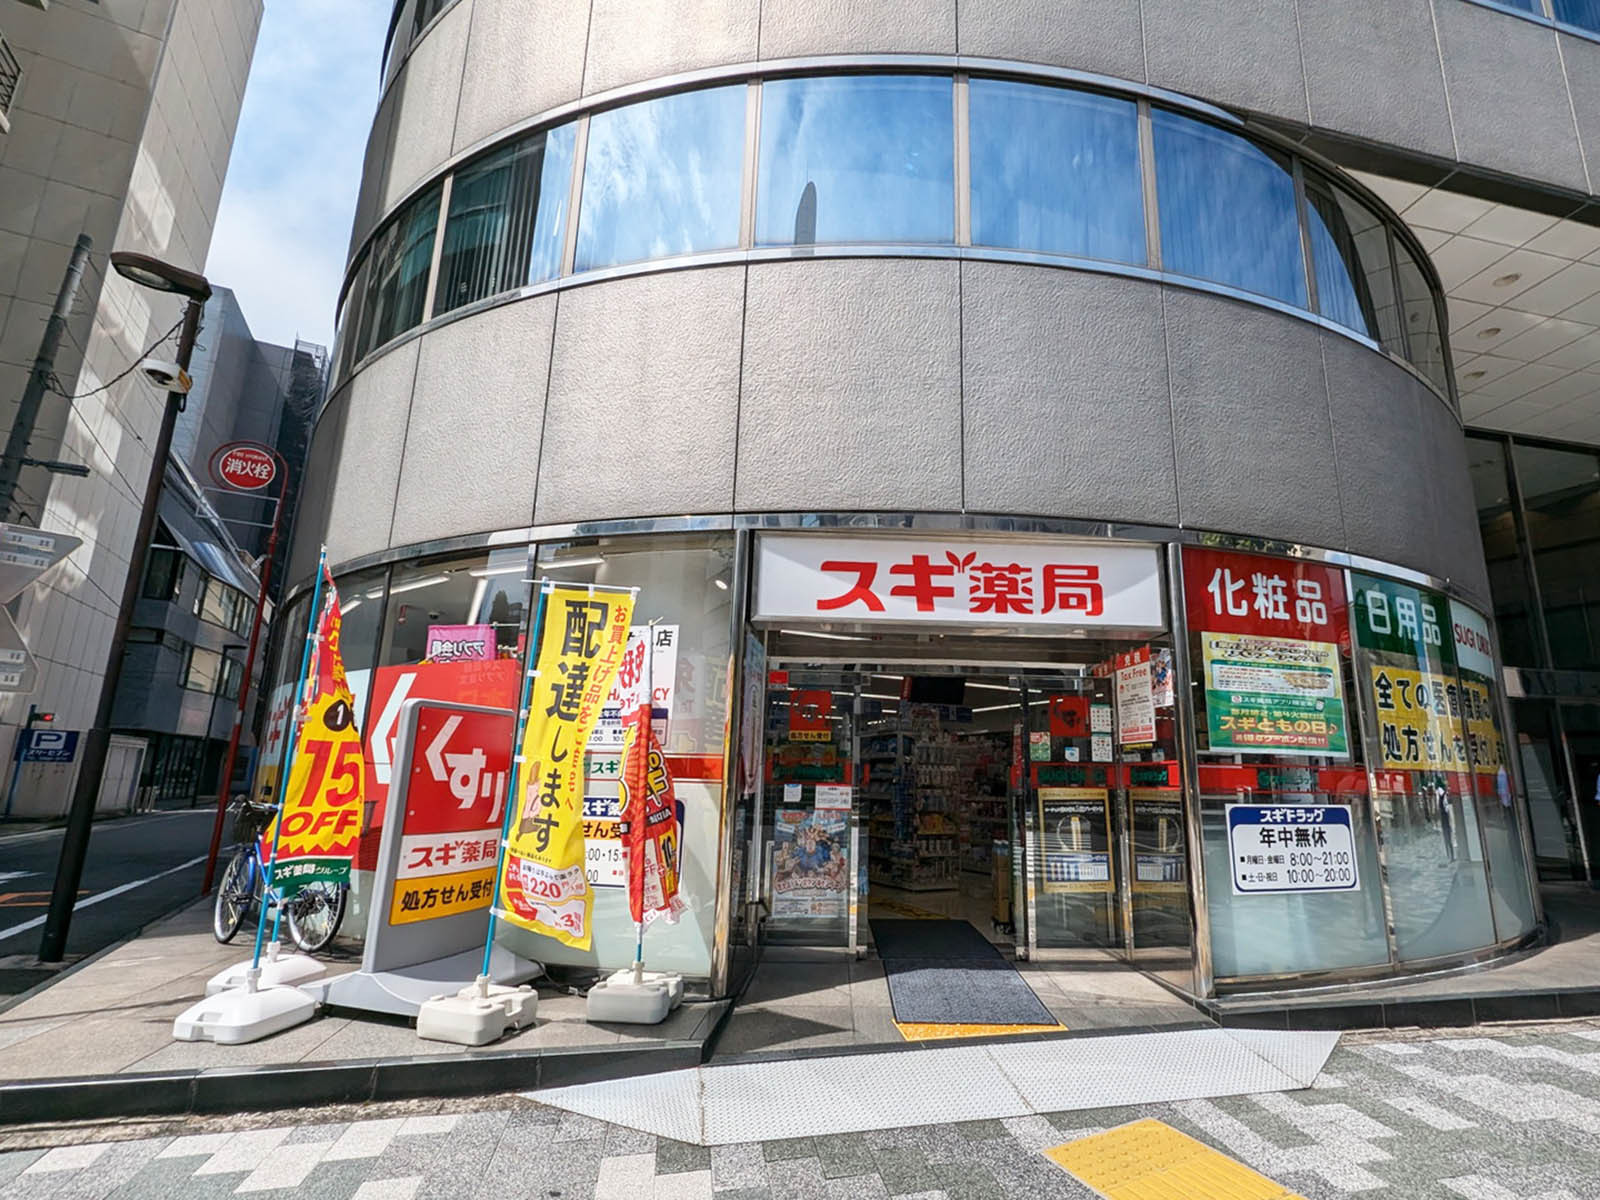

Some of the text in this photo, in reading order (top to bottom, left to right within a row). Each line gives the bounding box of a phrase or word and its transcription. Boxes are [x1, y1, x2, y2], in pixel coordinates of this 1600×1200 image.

[225, 457, 272, 480] 消火栓
[816, 551, 1104, 617] スギ薬局
[1207, 567, 1328, 626] 化粧品
[1366, 589, 1442, 647] 日用品
[535, 599, 610, 854] 配達します
[298, 740, 362, 807] 15
[424, 715, 506, 824] くすり
[279, 809, 359, 837] OFF
[1259, 808, 1326, 823] スギドラッグ
[1259, 826, 1328, 848] 年中無休
[407, 839, 498, 869] スギ薬局
[400, 879, 495, 912] 処方せん受付
